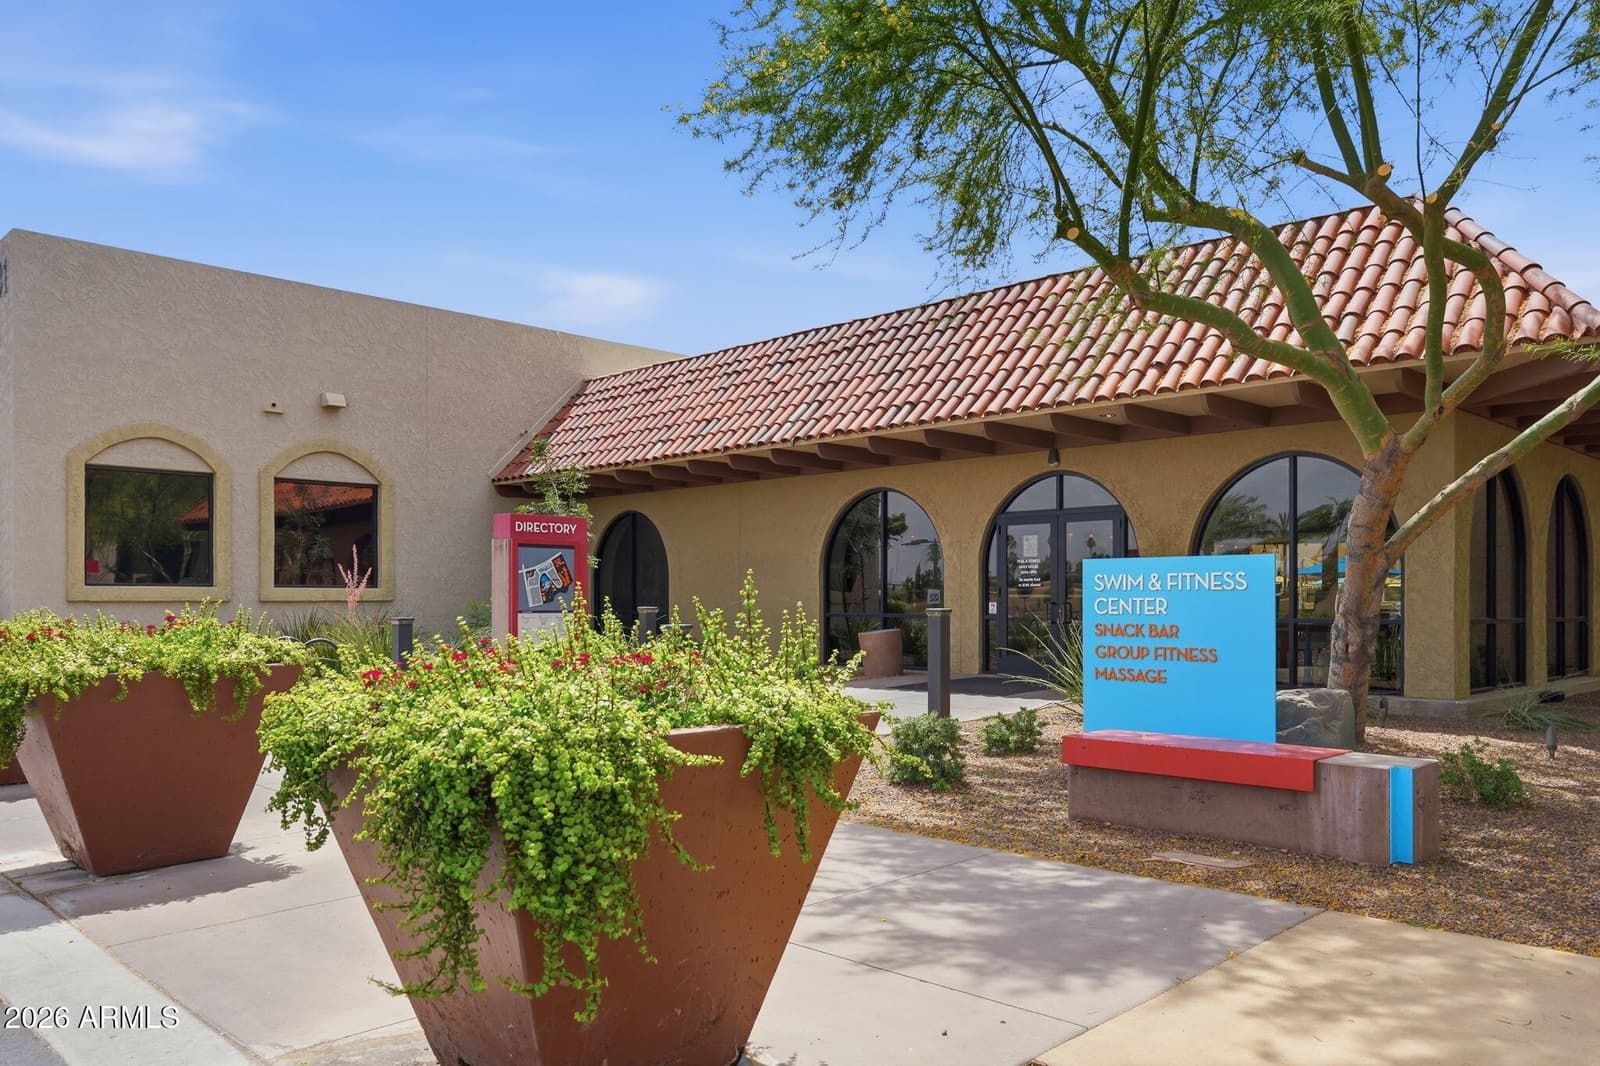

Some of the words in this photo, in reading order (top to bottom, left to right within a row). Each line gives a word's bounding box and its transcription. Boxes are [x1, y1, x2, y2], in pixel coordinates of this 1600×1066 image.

[515, 521, 577, 534] DIRECTORY
[1094, 573, 1144, 591] SWIM
[1148, 573, 1162, 591] &
[1167, 572, 1248, 591] FITNESS
[1094, 597, 1168, 615] CENTER
[1094, 623, 1145, 638] SNACK
[1148, 623, 1179, 639] BAR
[1095, 645, 1150, 660] GROUP
[1153, 646, 1218, 663] FITNESS
[1094, 667, 1167, 684] MASSAGE
